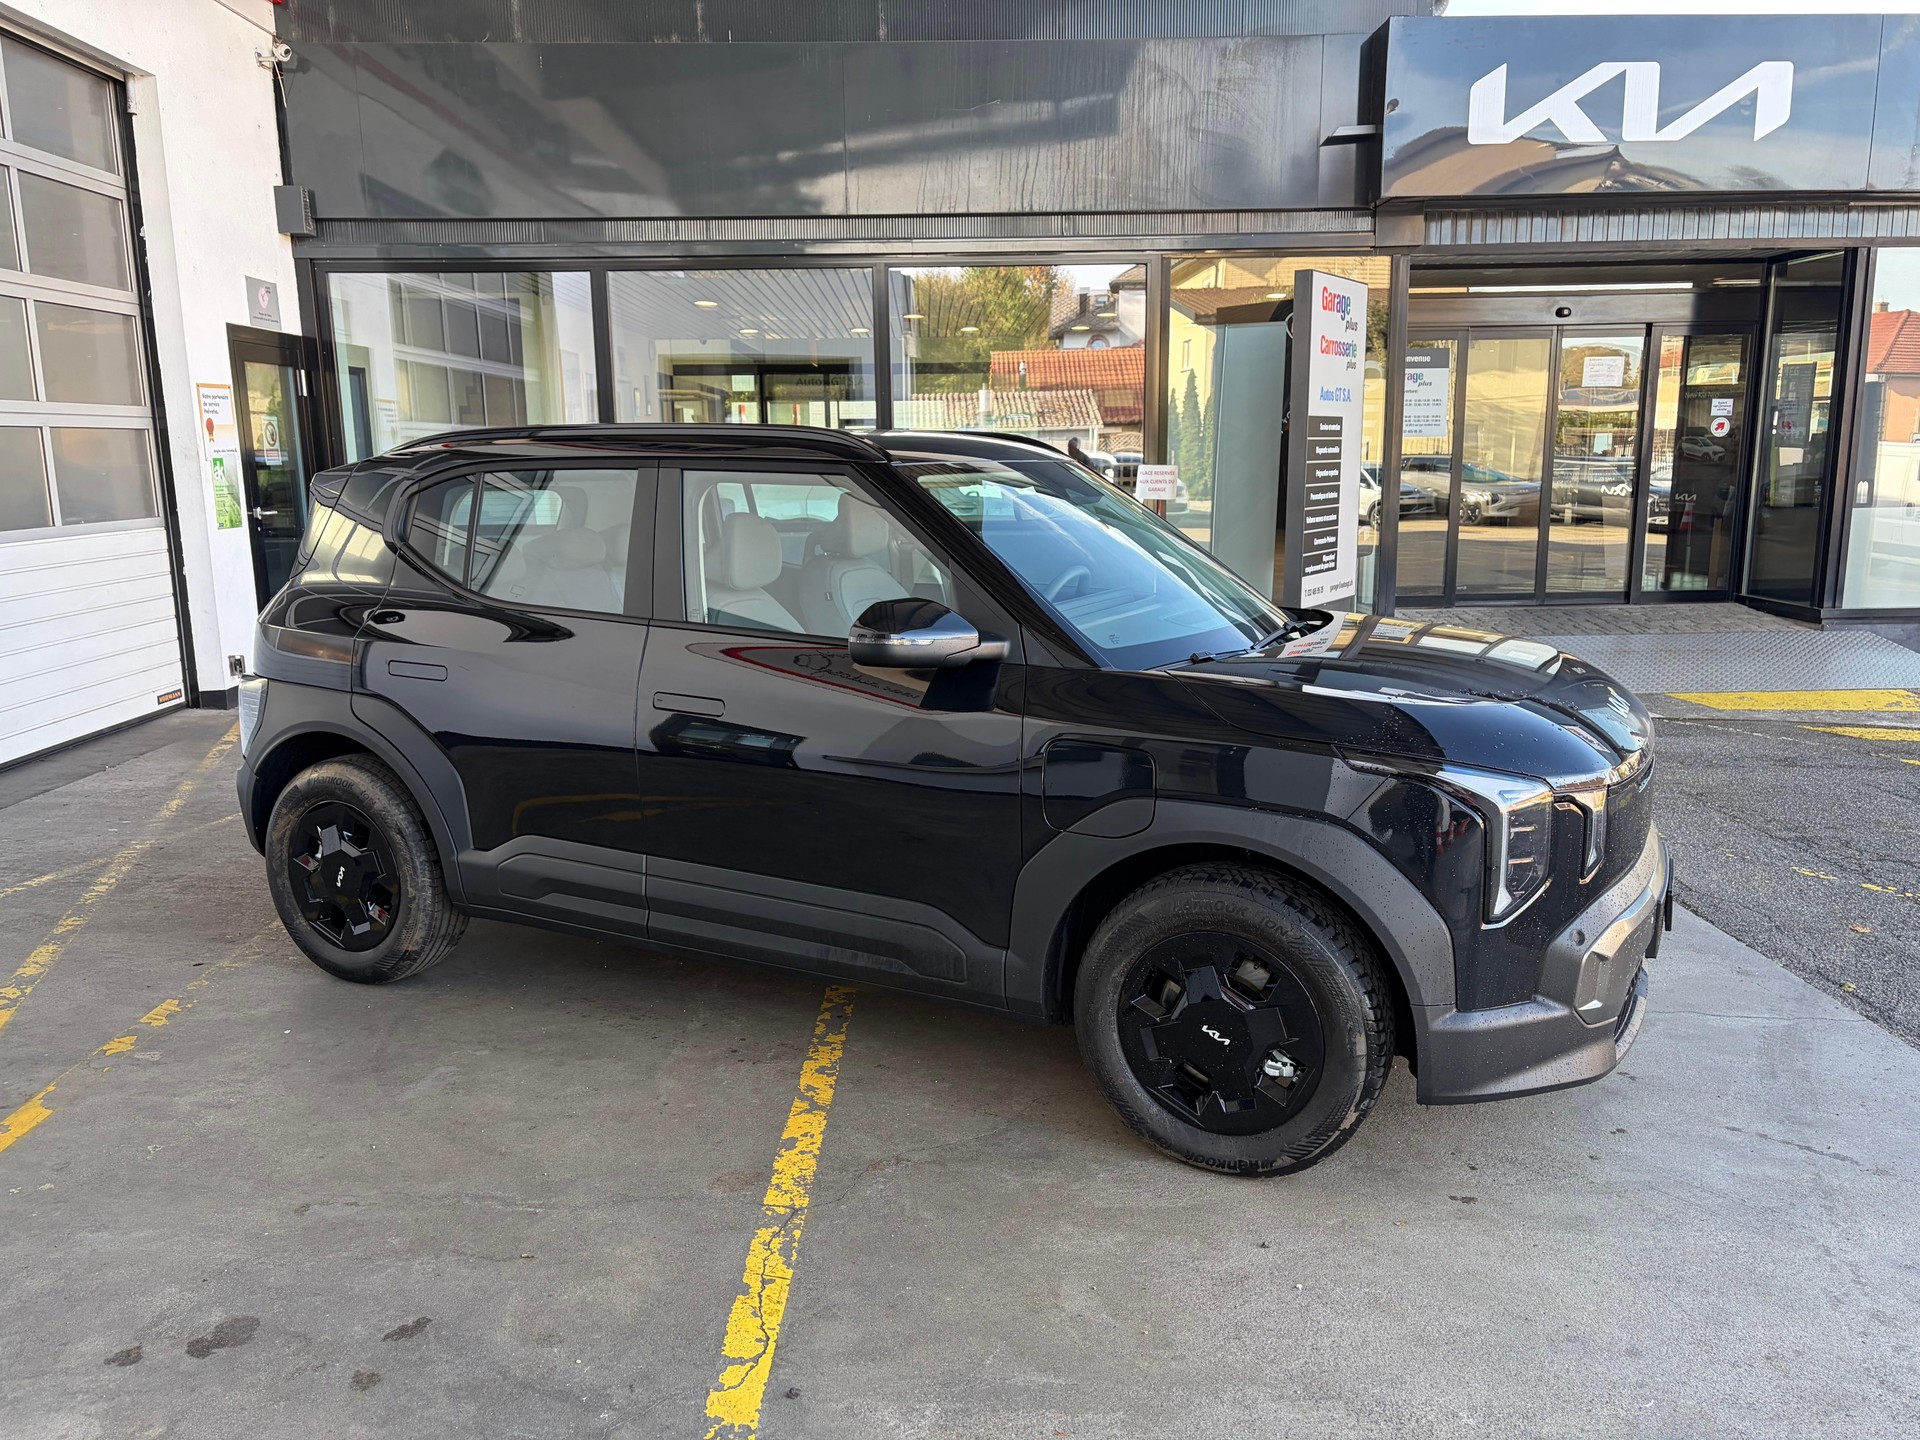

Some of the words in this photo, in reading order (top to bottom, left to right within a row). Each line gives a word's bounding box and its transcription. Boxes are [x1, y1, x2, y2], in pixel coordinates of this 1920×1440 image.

[1468, 61, 1794, 145] KIA
[1321, 286, 1351, 321] Garage
[1345, 317, 1358, 332] plus
[1320, 335, 1357, 359] Carrosserie
[1345, 359, 1357, 371] plus
[1319, 386, 1334, 402] Autos
[1335, 387, 1342, 402] GT
